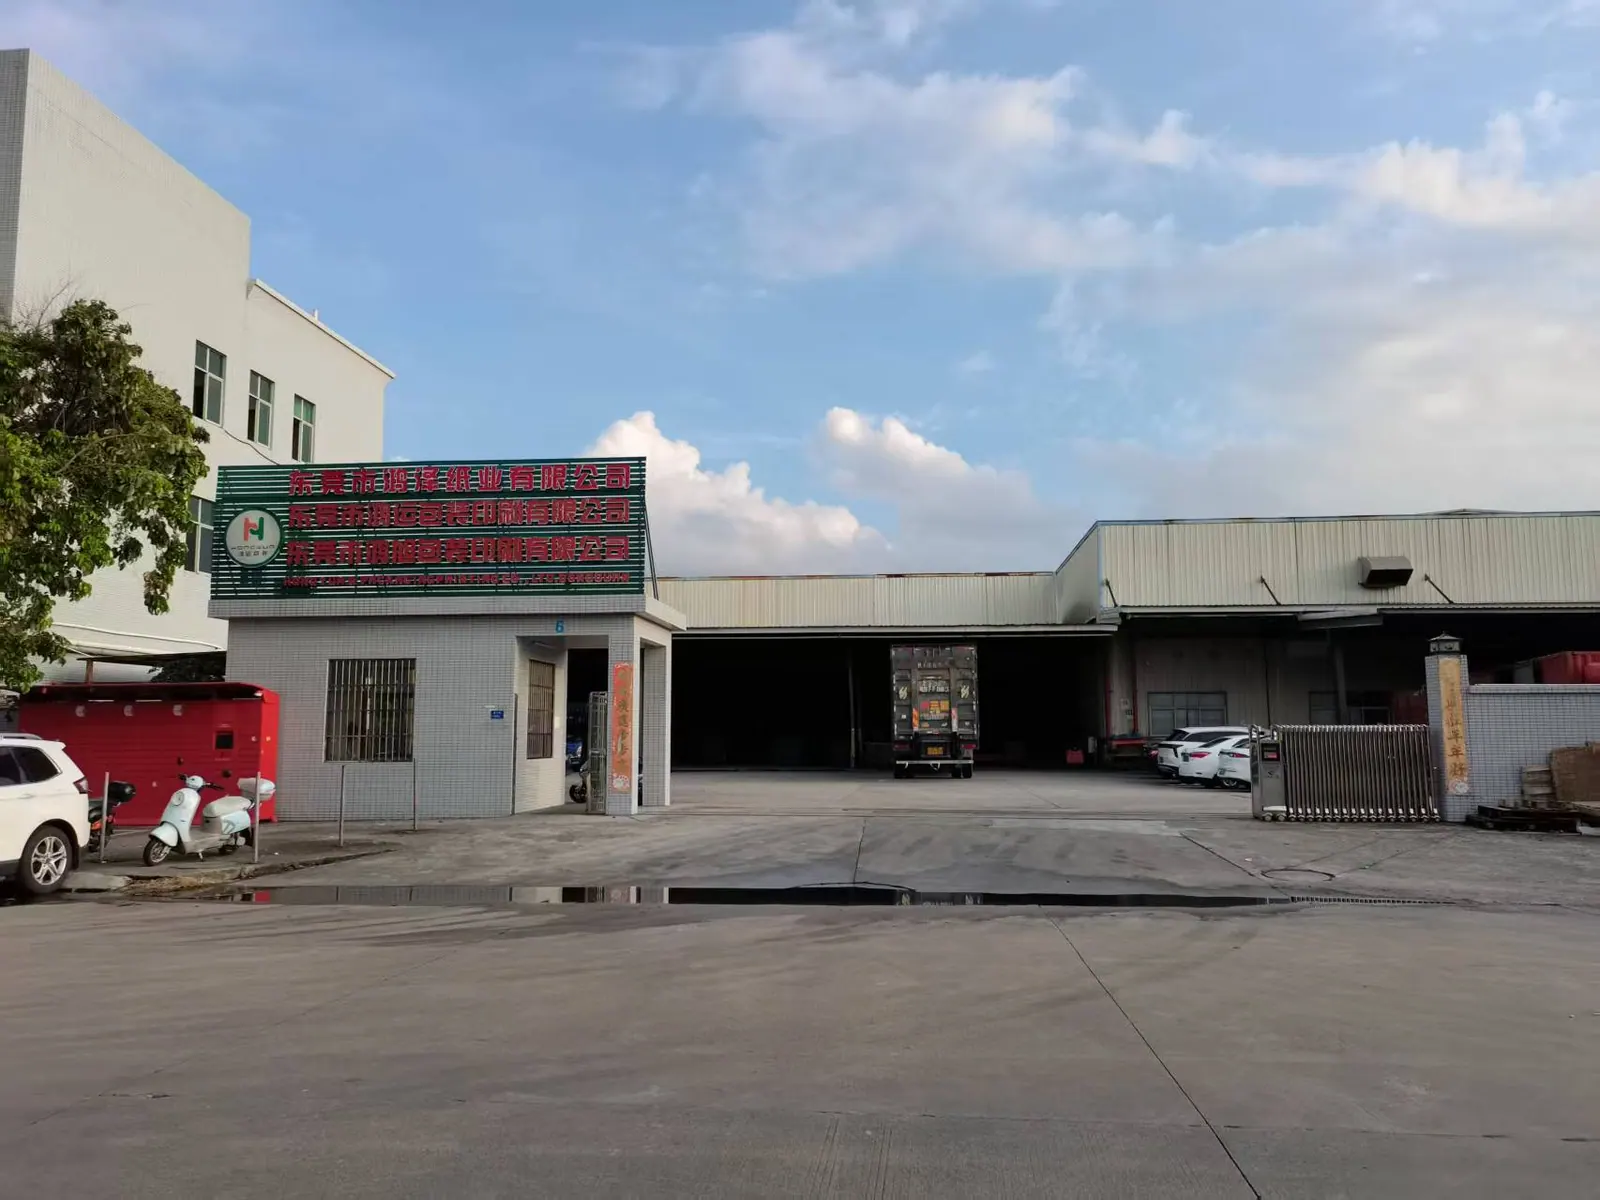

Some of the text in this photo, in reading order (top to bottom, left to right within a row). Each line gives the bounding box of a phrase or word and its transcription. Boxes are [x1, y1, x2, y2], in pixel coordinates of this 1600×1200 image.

[288, 464, 631, 496] 东莞市鸿泽纸业有限公司
[288, 498, 630, 528] 东莞市鸿运包装印刷有限公司
